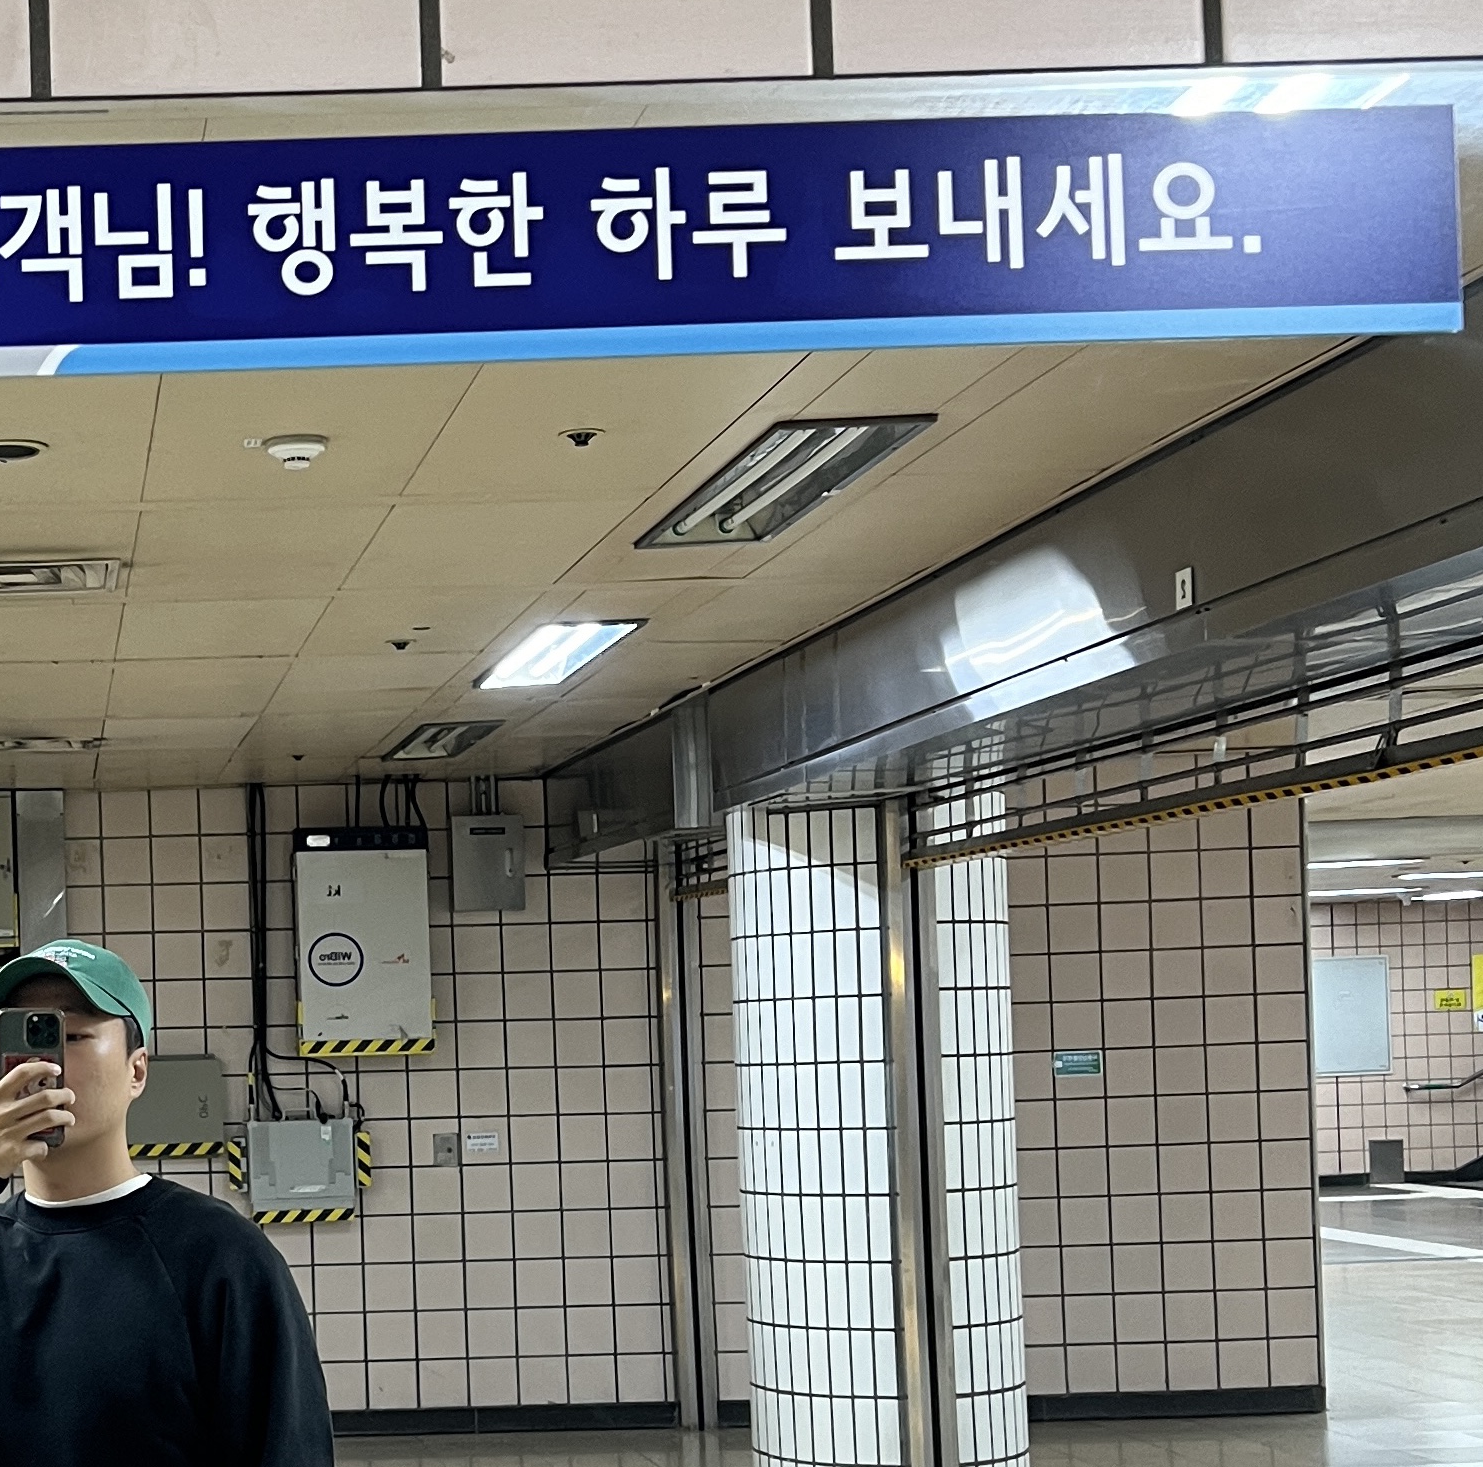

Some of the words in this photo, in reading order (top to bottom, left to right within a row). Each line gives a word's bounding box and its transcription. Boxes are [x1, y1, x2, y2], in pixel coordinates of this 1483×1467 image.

[247, 172, 544, 296] 행복한
[590, 167, 787, 281] 하루
[834, 153, 1261, 269] 보내세요.
